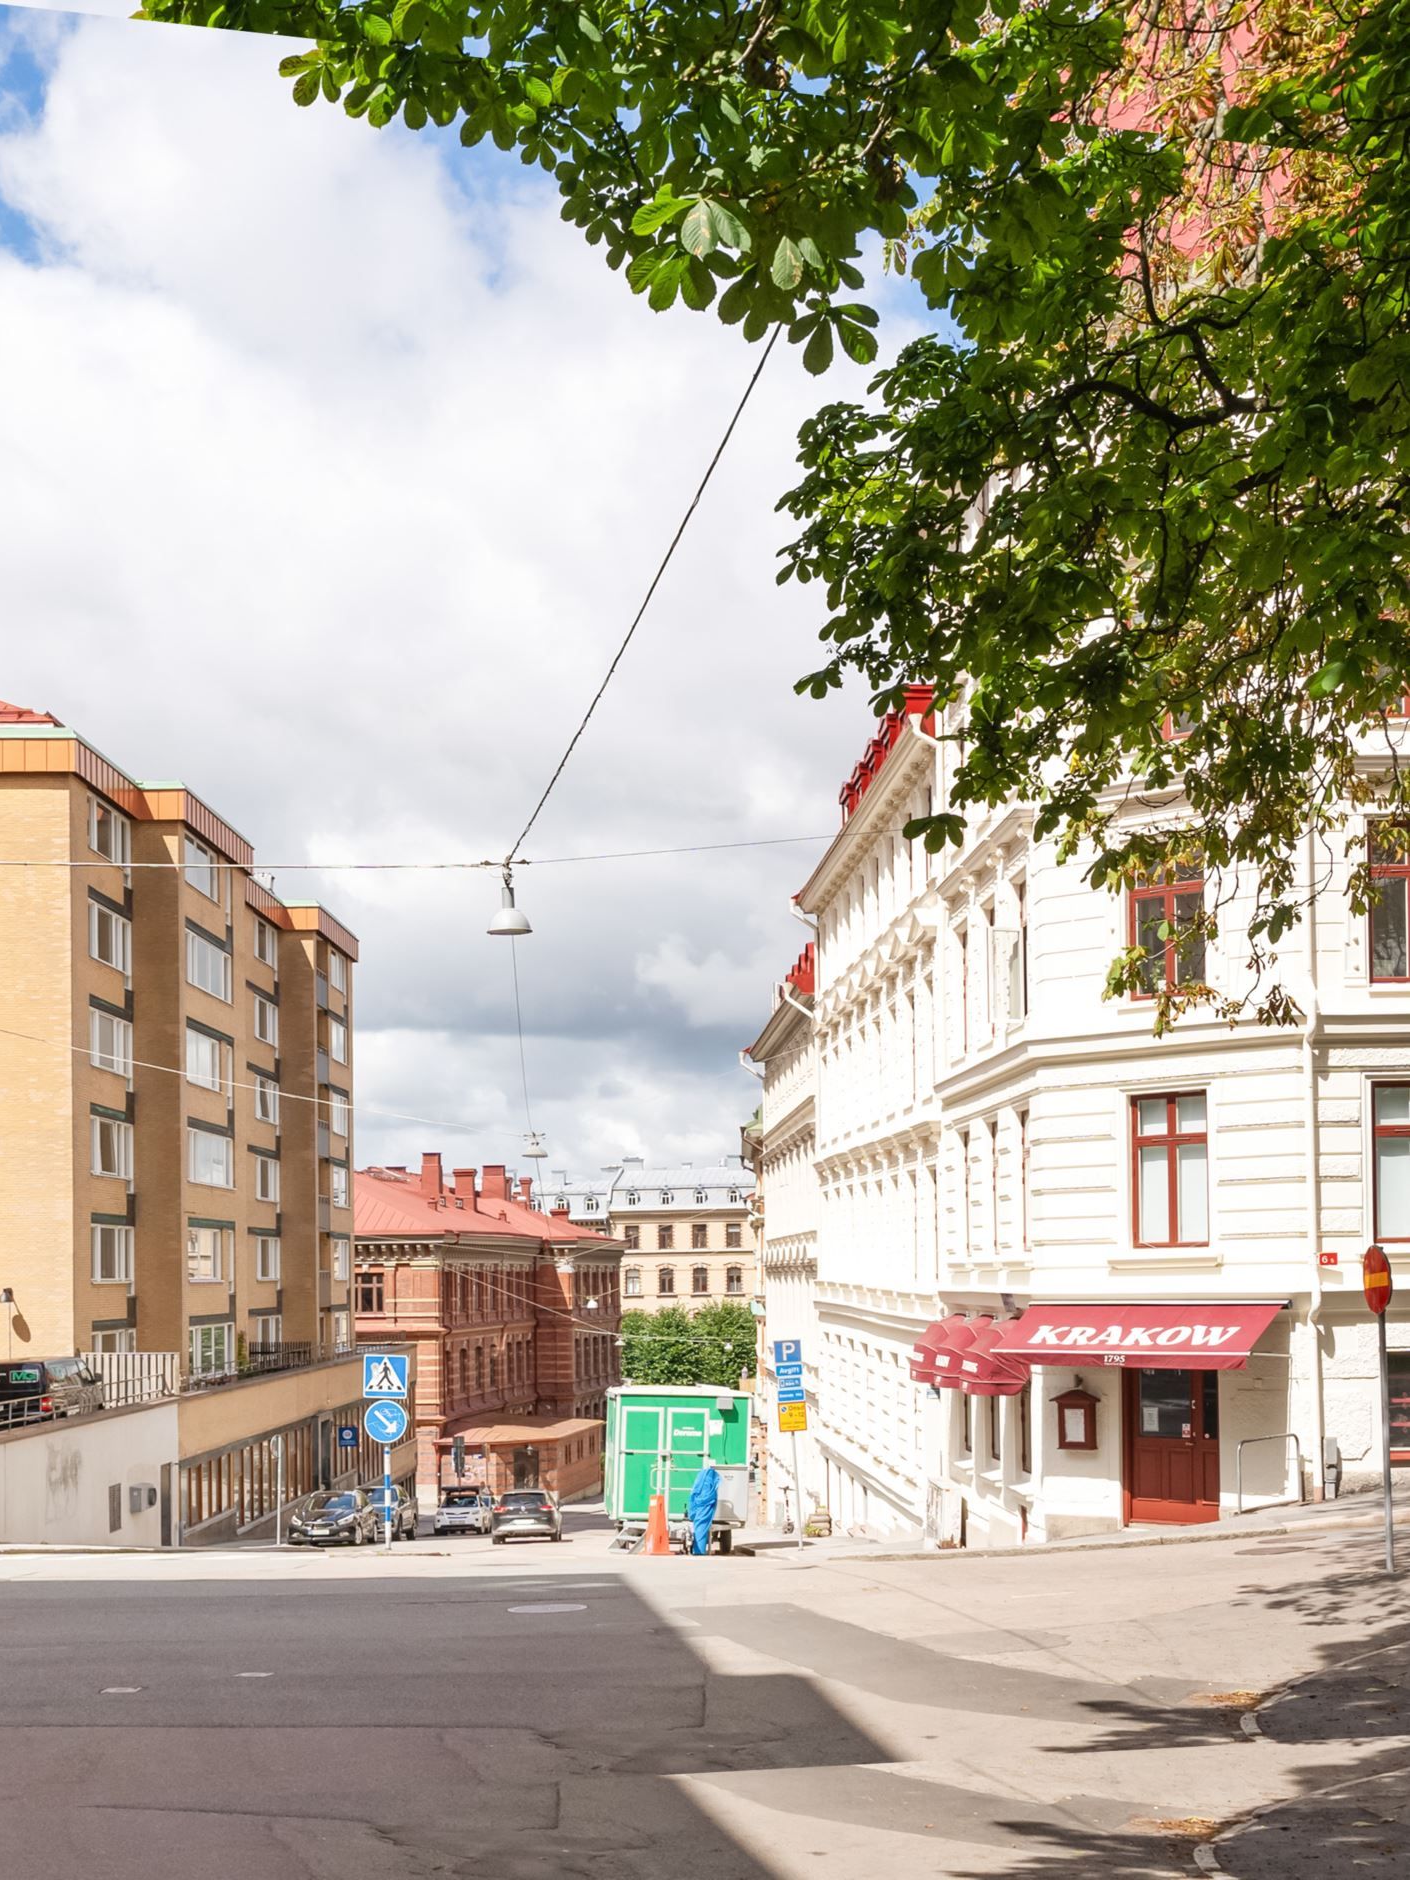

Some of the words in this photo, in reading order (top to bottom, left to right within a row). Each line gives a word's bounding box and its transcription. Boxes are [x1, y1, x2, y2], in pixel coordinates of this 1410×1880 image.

[1027, 1325, 1242, 1346] KRAKOW
[782, 1342, 796, 1361] P
[1103, 1354, 1126, 1363] 1795
